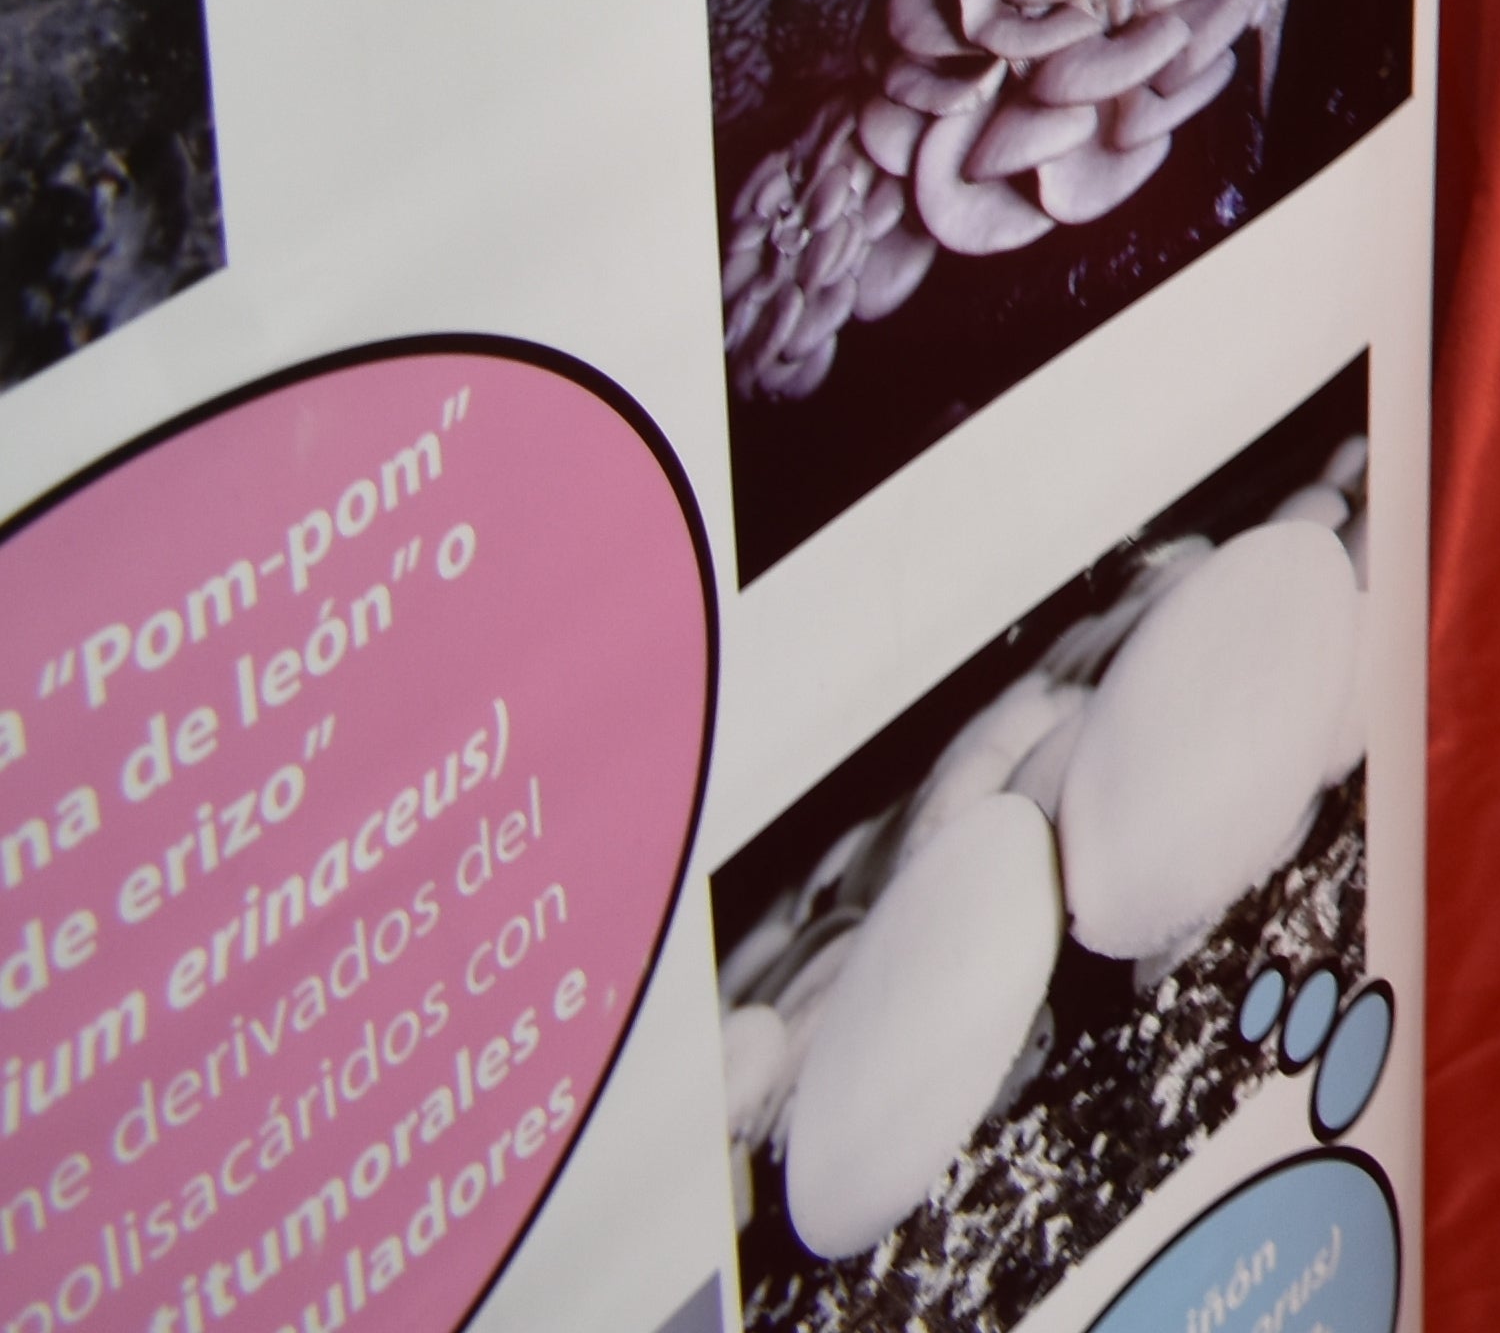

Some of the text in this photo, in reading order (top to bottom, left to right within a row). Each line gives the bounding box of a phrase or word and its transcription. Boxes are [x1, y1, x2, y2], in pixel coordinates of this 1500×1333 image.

[120, 704, 220, 804] de
[435, 521, 476, 581] o
[167, 695, 510, 1011] erinaceus)
[465, 882, 568, 995] con
[0, 909, 98, 1010] de
[112, 879, 442, 1165] derivados
[456, 774, 543, 896] del
[554, 967, 588, 1022] e
